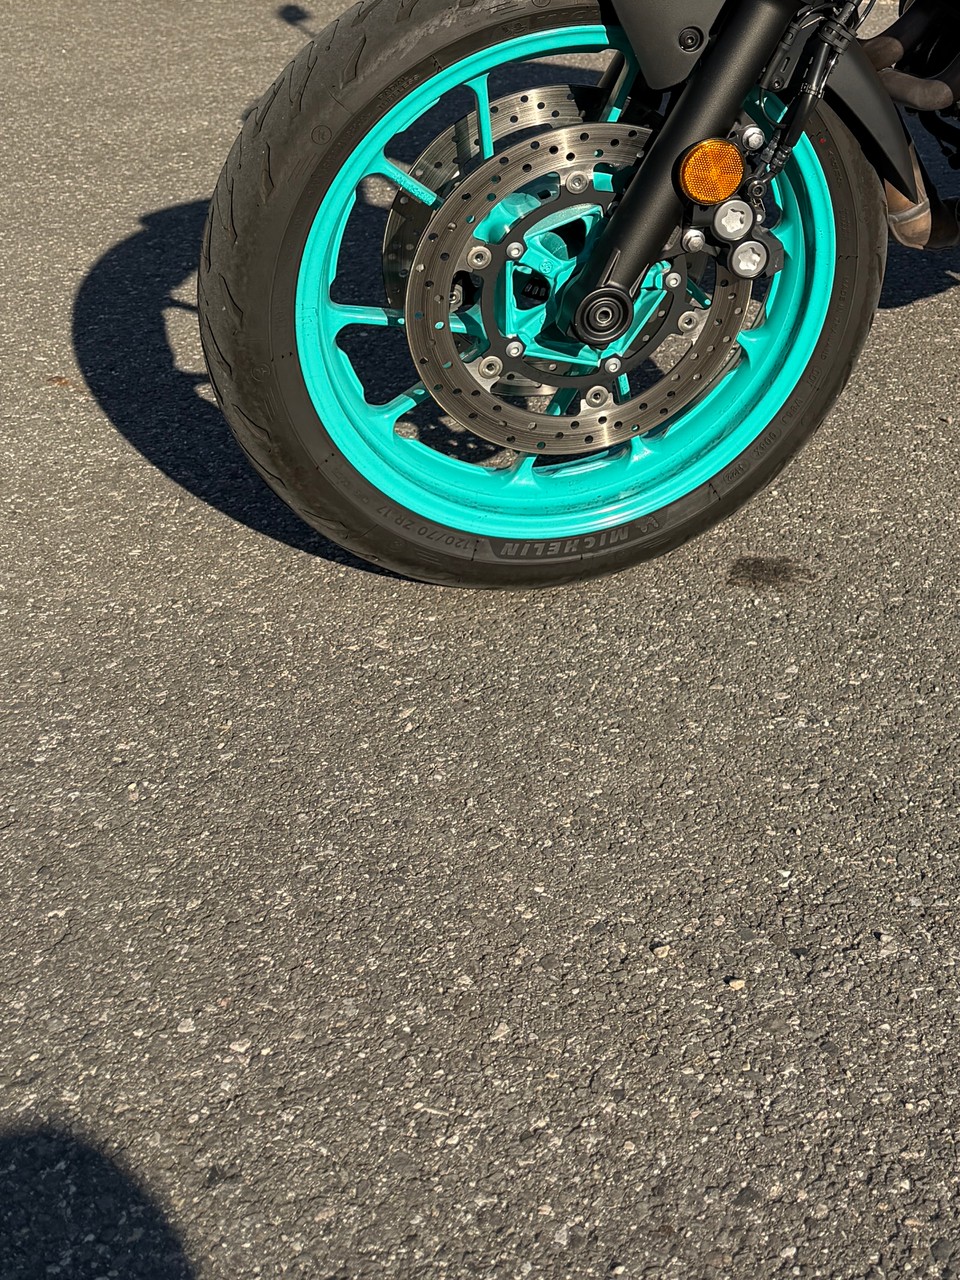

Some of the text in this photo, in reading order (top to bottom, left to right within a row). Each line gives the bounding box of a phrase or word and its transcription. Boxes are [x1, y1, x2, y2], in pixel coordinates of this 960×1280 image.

[375, 503, 469, 550] 120/70 ZR 17
[501, 526, 630, 557] MICHELIN
